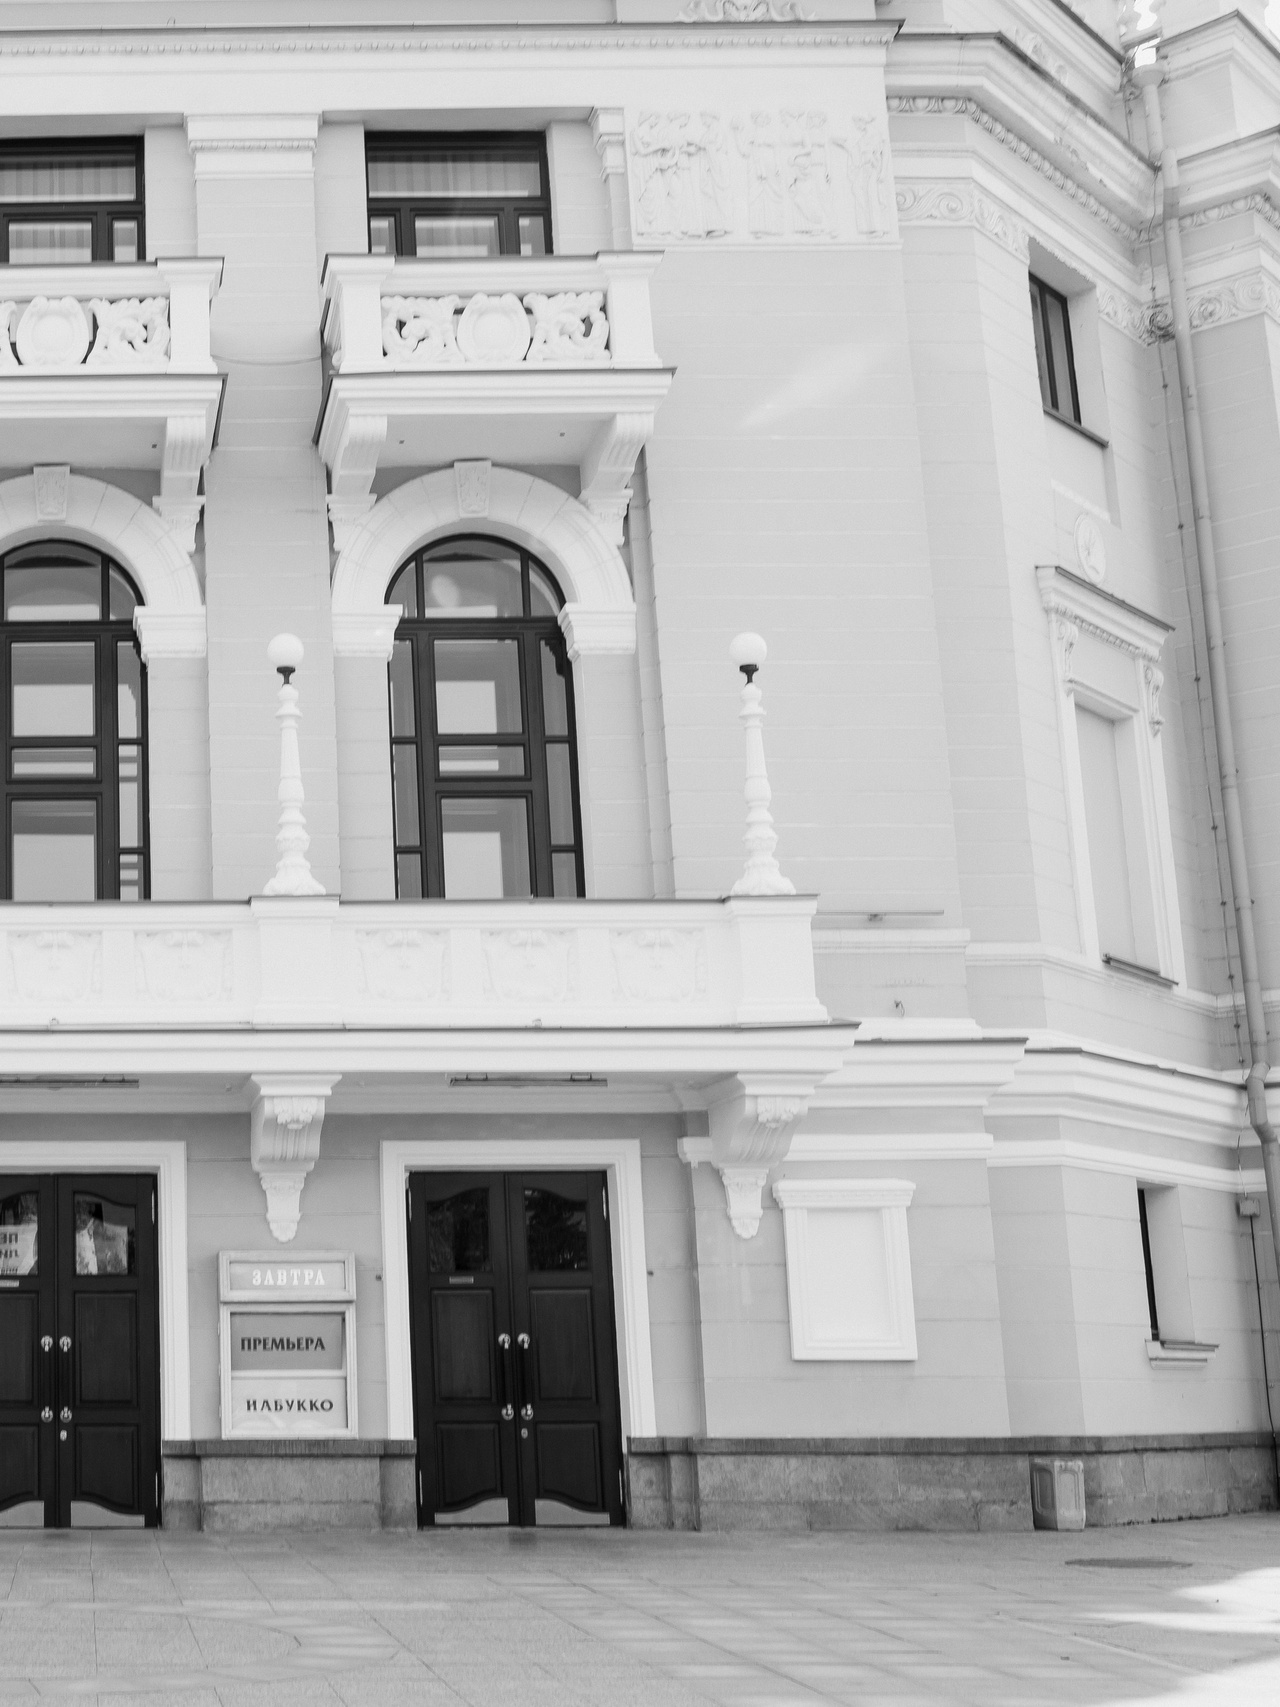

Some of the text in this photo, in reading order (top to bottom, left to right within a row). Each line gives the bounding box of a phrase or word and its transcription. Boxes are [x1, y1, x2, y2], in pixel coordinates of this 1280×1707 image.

[252, 1268, 325, 1286] ЗАВТРА
[240, 1336, 326, 1352] ПРЕМЬЕРА
[246, 1398, 334, 1413] НАБУККО
